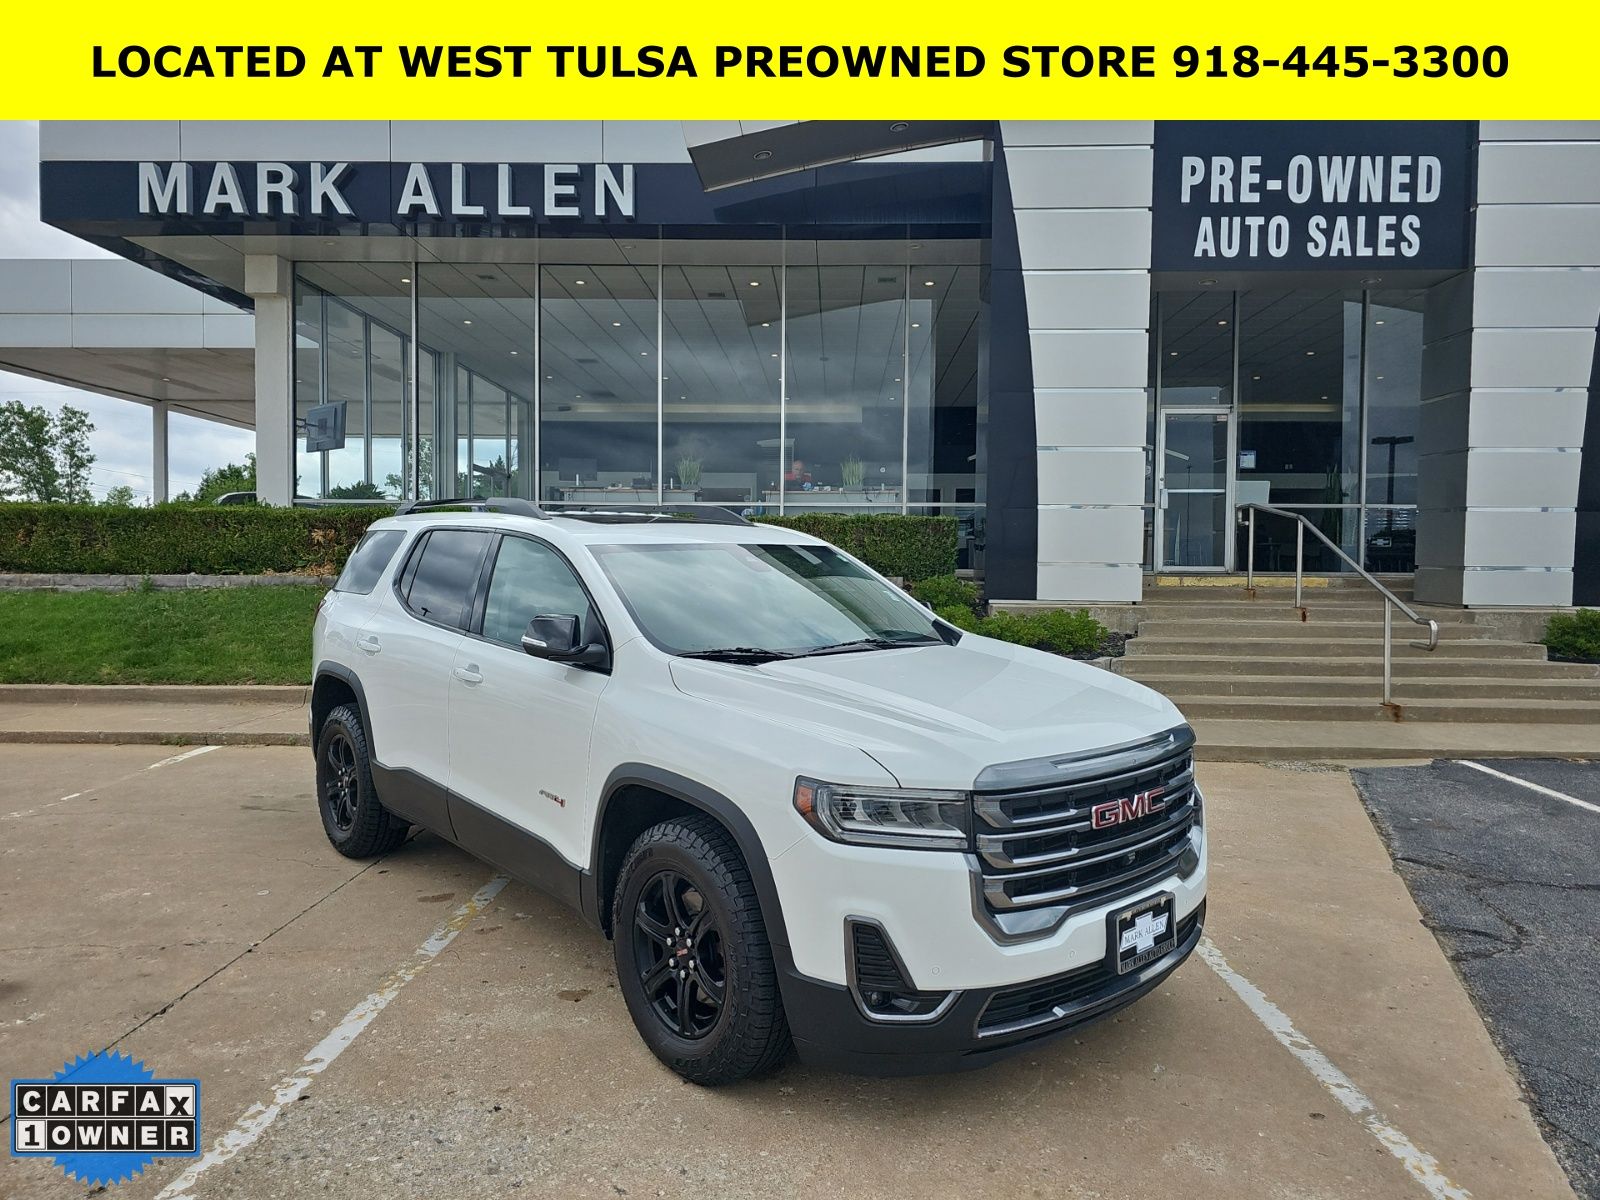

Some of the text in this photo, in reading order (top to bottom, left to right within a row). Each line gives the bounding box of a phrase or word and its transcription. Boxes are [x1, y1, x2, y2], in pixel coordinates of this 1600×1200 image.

[137, 162, 636, 218] MARK ALLEN
[1180, 154, 1443, 205] PRE-OWNED
[1193, 214, 1421, 258] AUTO SALES
[1091, 786, 1166, 830] GMC
[1124, 921, 1164, 944] MARK ALLEN
